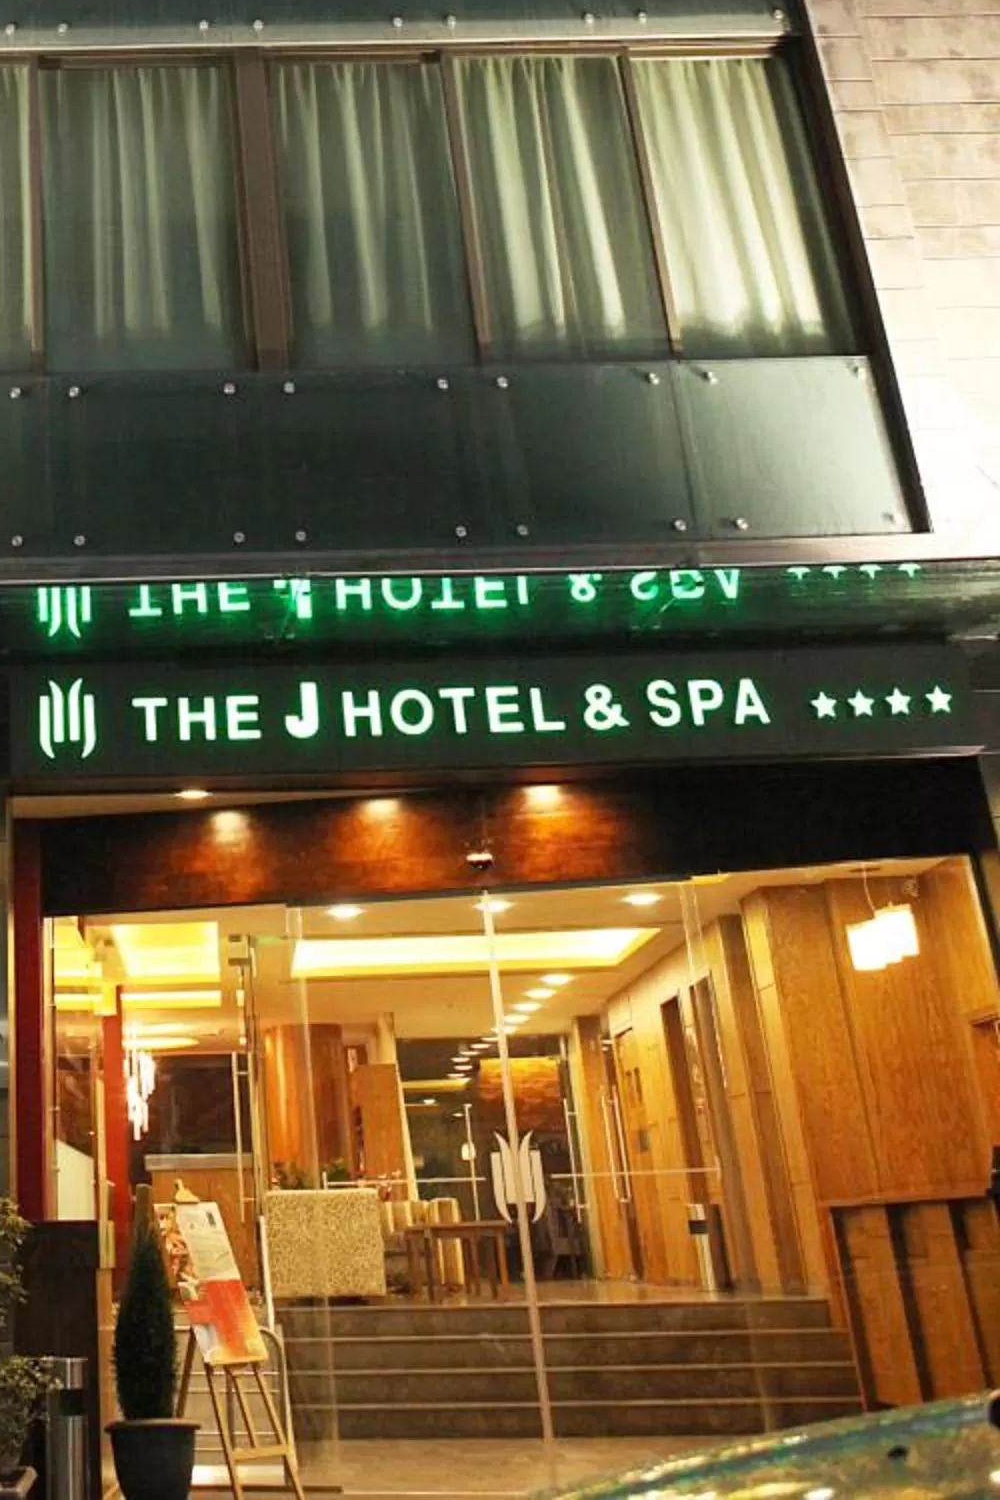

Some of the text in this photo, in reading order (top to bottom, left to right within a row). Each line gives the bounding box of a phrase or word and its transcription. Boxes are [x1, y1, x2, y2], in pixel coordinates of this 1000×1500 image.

[132, 695, 262, 741] THE
[341, 685, 566, 737] HOTEL
[583, 684, 630, 730] &
[645, 677, 771, 727] SPA
